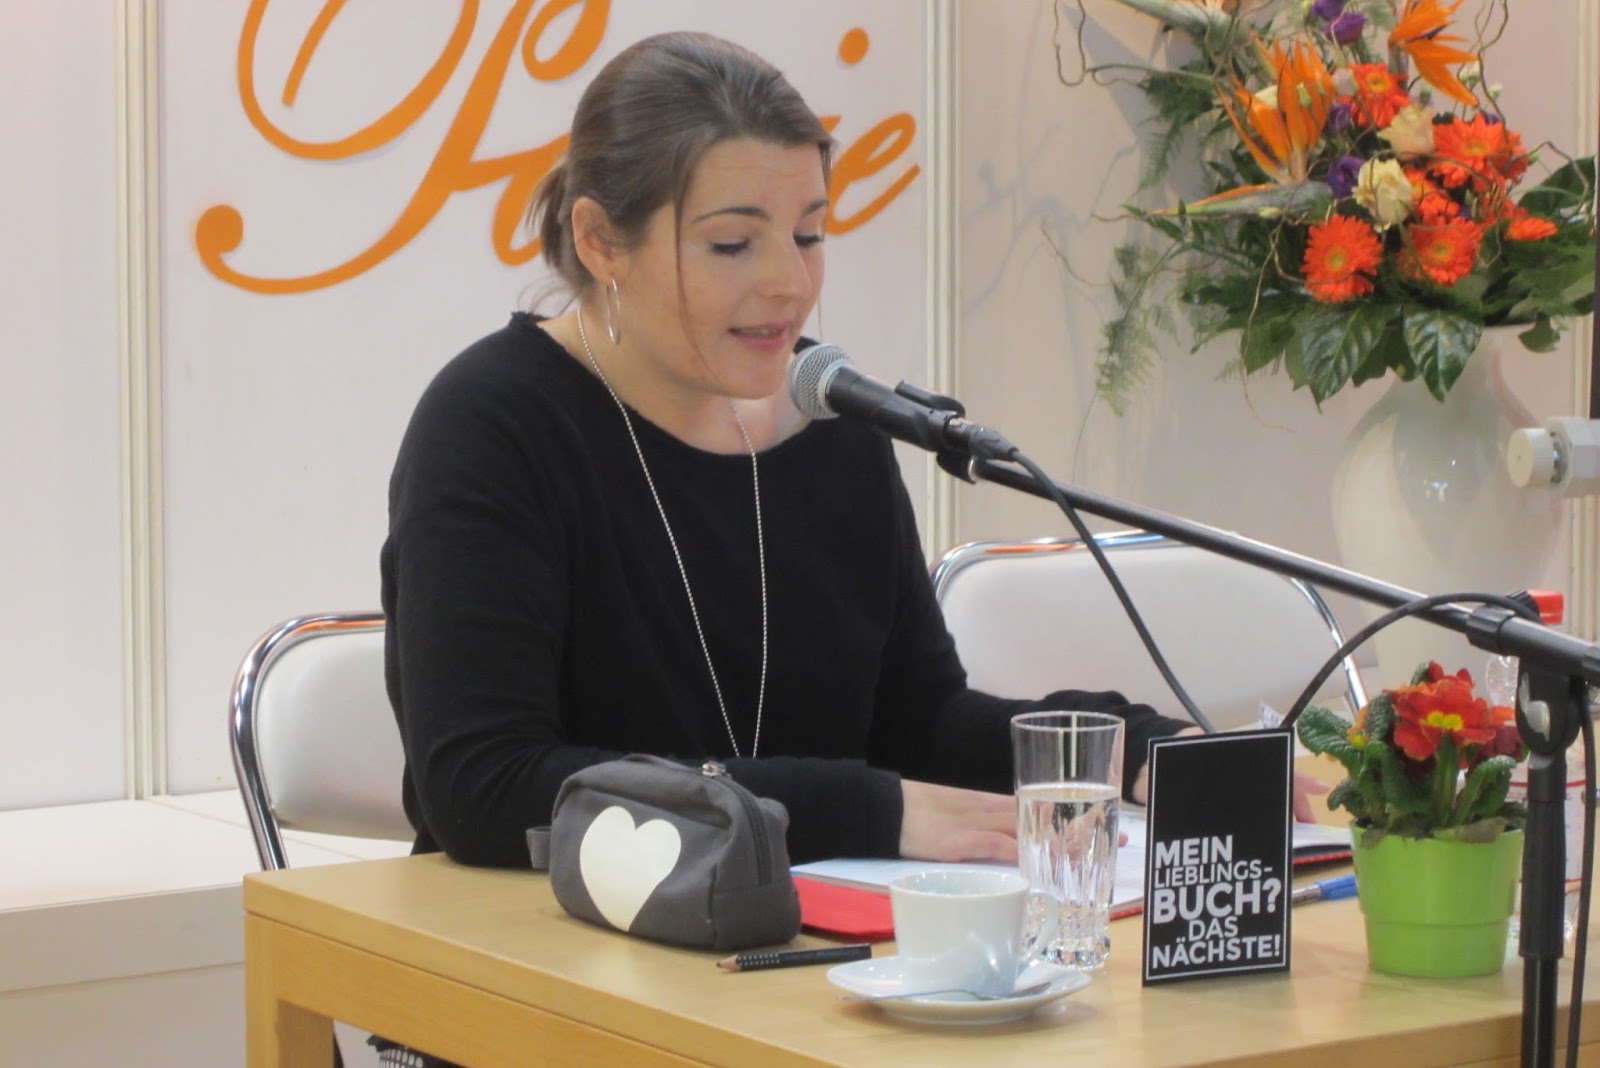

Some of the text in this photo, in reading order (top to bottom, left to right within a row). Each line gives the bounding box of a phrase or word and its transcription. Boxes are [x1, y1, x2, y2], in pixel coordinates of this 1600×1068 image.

[1155, 835, 1233, 869] MEIN
[1154, 859, 1273, 889] LIEBLINGS-
[1153, 878, 1282, 924] BUCH?
[1188, 916, 1238, 941] DAS
[1152, 934, 1281, 969] NÄCHSTE!
